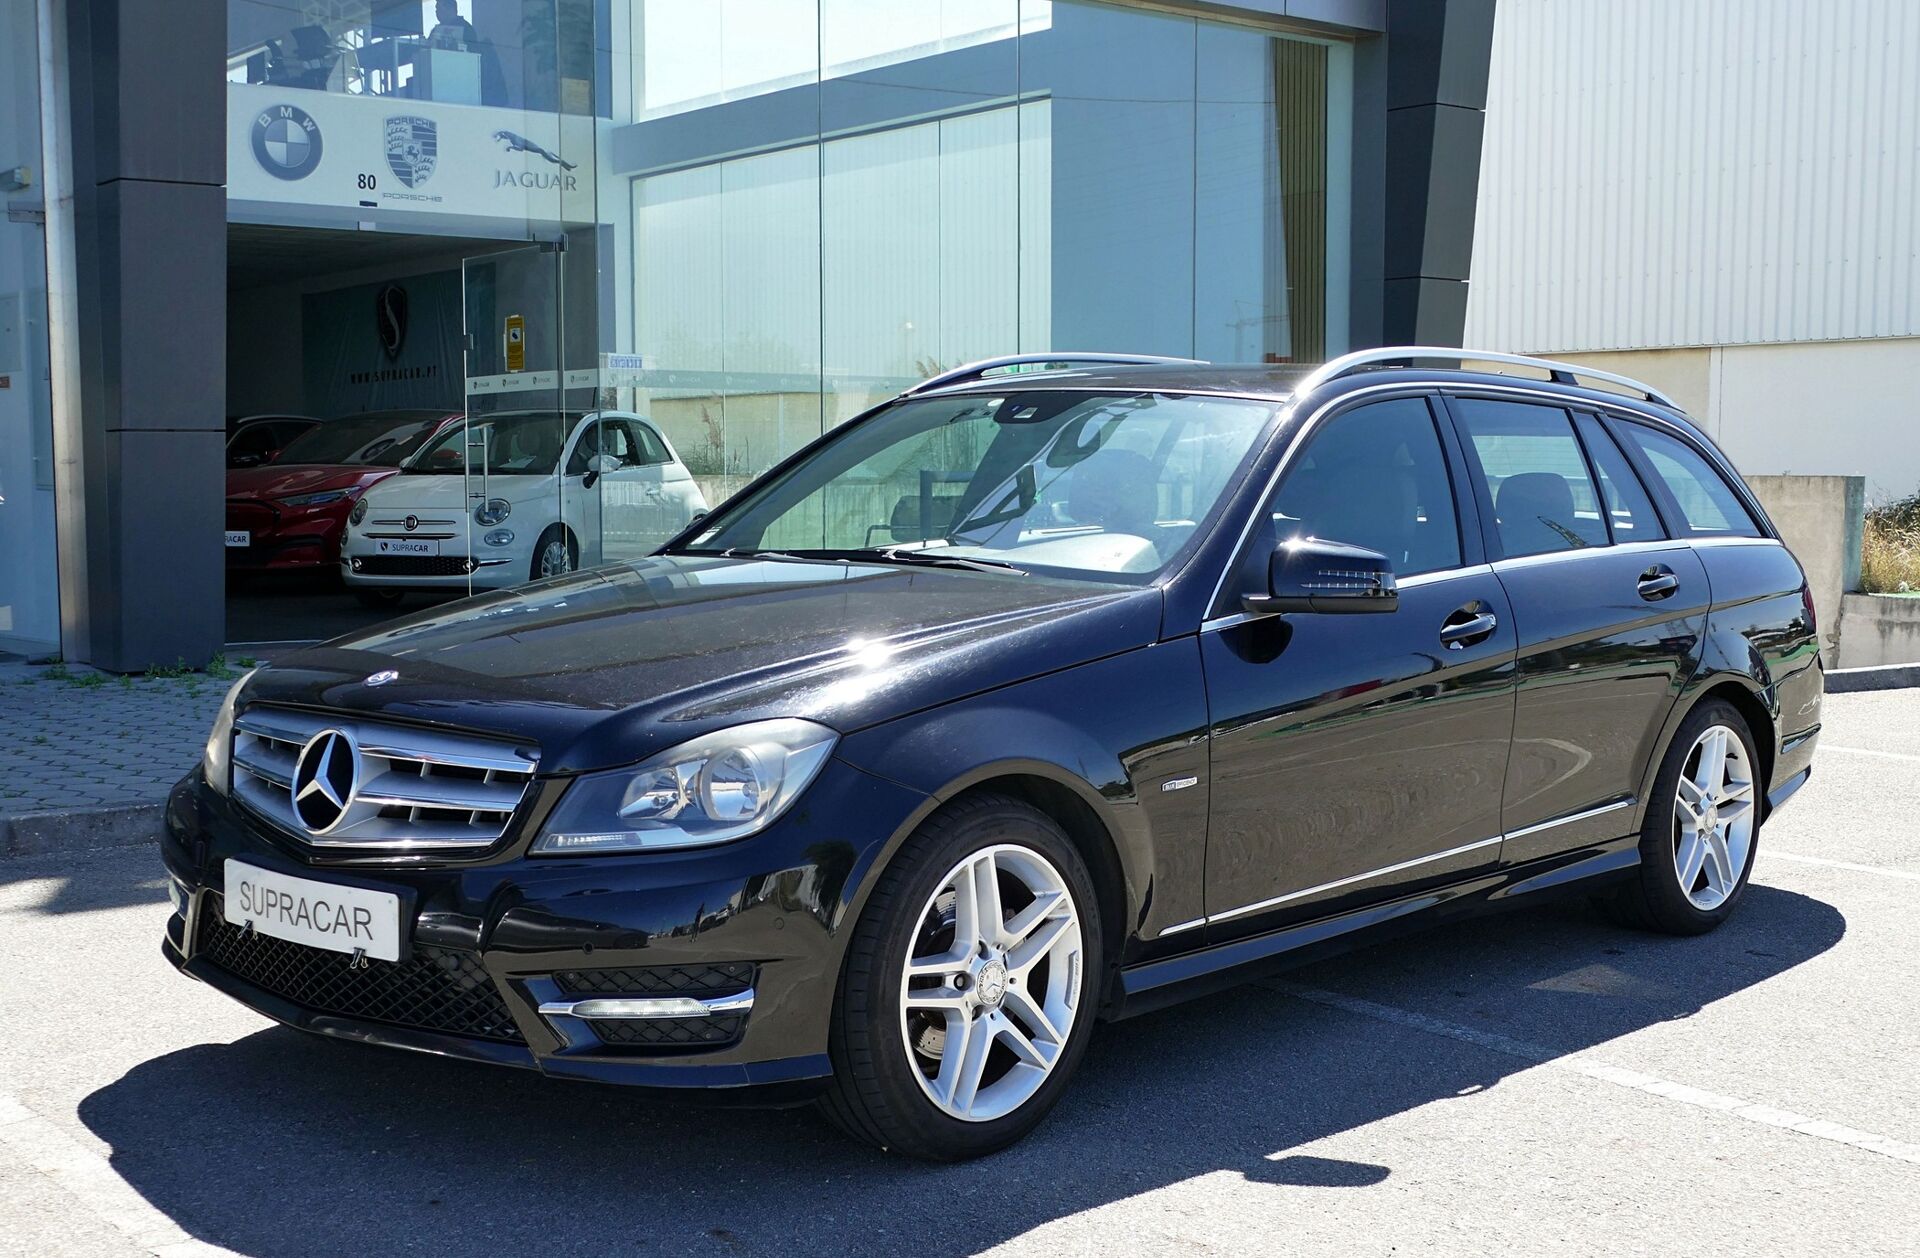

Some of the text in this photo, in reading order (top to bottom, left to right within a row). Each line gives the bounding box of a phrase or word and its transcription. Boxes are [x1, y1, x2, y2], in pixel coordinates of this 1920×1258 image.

[258, 106, 316, 131] BMW
[357, 174, 376, 190] 80
[493, 170, 577, 191] JAGUAR
[383, 192, 442, 202] PORSCHE
[225, 535, 247, 543] RACAR
[392, 543, 429, 552] SUPRACAR
[239, 880, 373, 941] SUPRACAR
